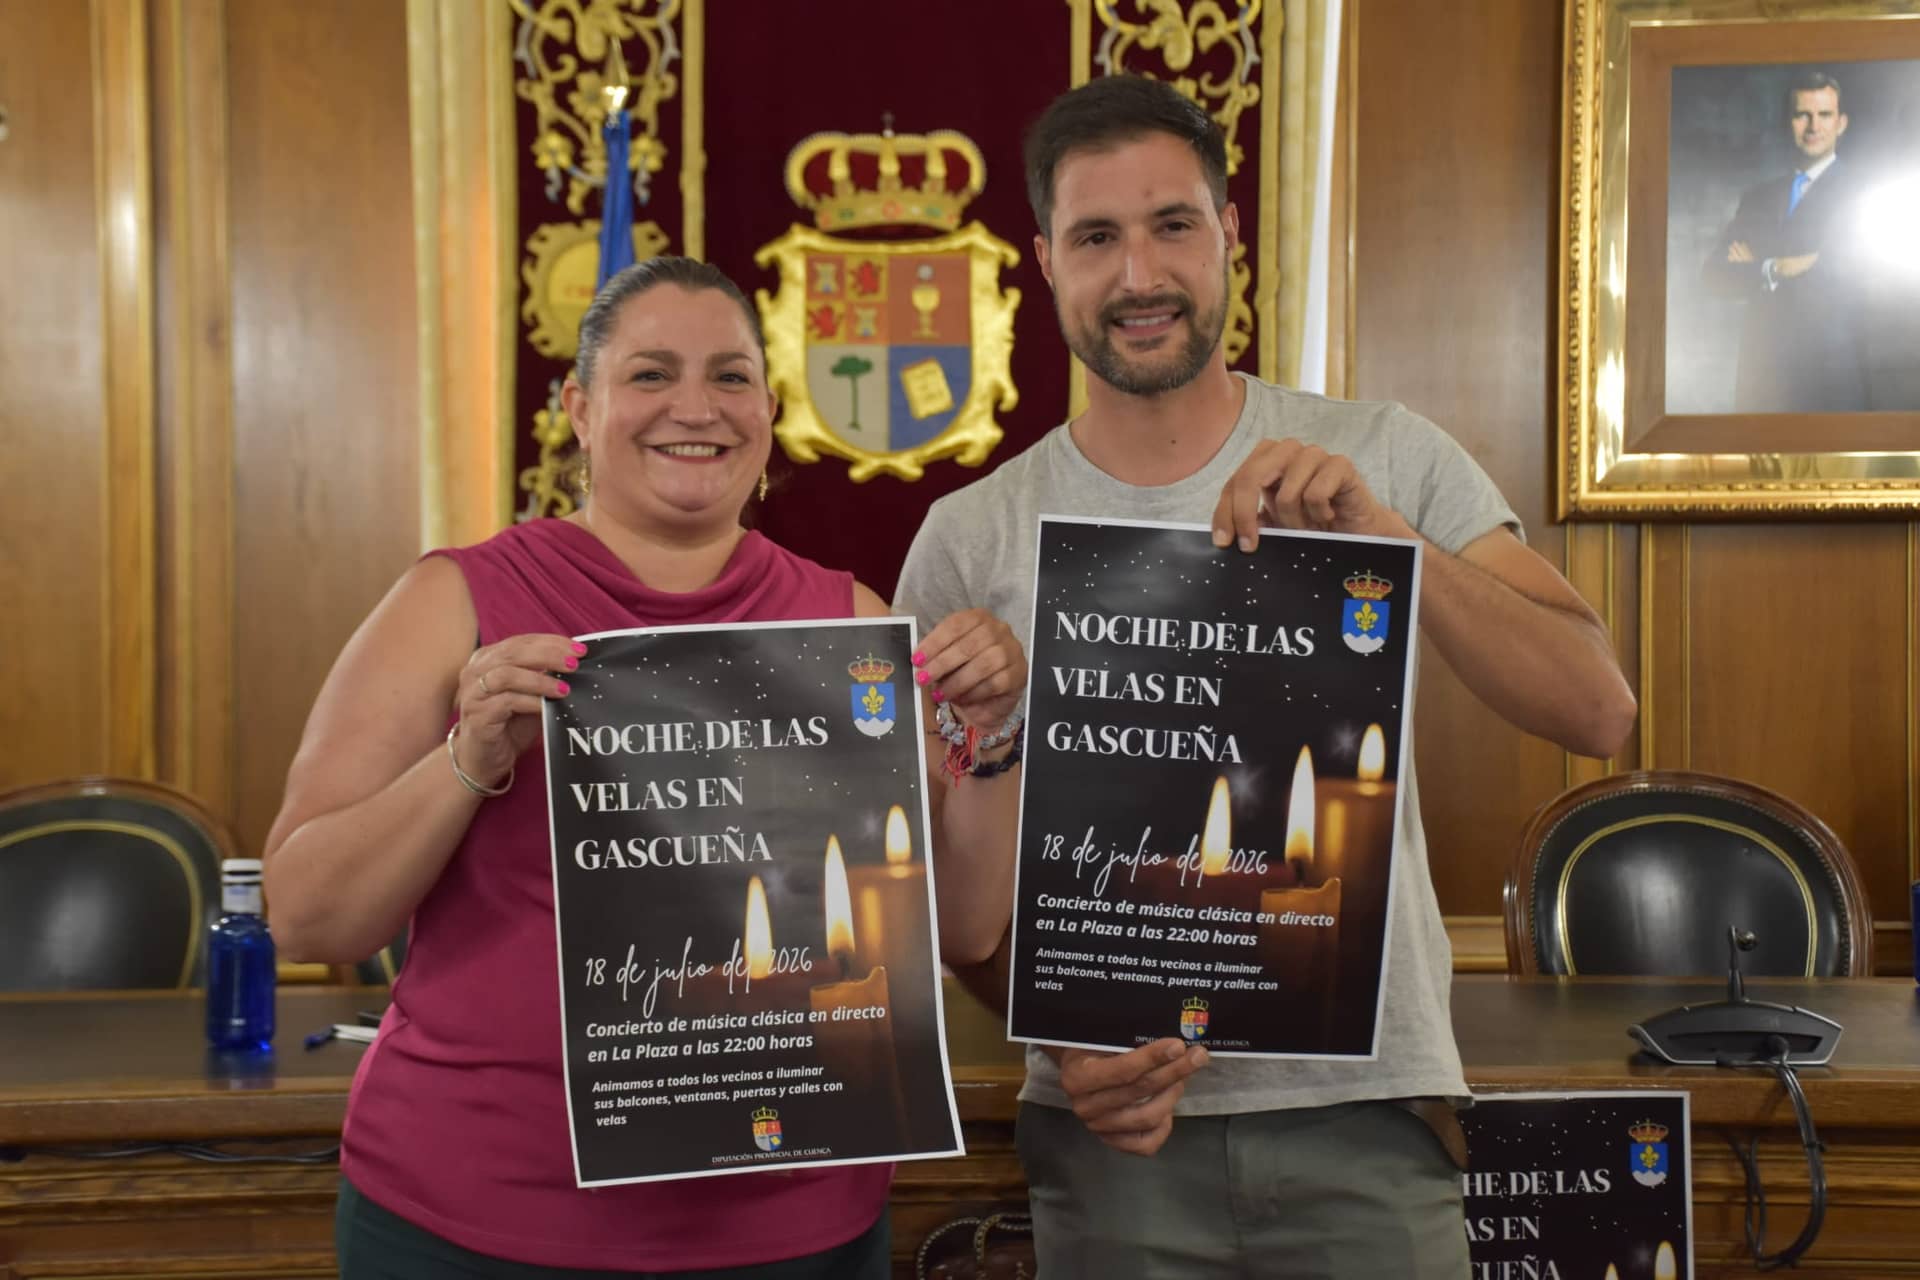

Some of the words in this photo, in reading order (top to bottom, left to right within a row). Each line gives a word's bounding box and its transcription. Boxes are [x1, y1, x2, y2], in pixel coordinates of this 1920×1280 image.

[1055, 611, 1180, 648] NOCHE
[1189, 621, 1236, 652] DE
[1246, 624, 1315, 657] LAS
[1051, 666, 1165, 703] VELAS
[1174, 675, 1223, 707] EN
[567, 720, 695, 756] NOCHE
[705, 719, 753, 750] DE
[763, 716, 829, 748] LAS
[1047, 721, 1243, 764] GASCUEÑA
[569, 778, 687, 812] VELAS
[697, 776, 744, 808] EN
[574, 826, 773, 870] GASCUEÑA
[1042, 834, 1064, 860] 18
[1072, 826, 1101, 879] de
[1094, 826, 1168, 898] julio
[1222, 848, 1268, 875] 2026
[1037, 894, 1111, 912] Concierto
[1115, 900, 1135, 914] de
[1138, 903, 1194, 919] música
[1198, 906, 1252, 923] clásica
[1256, 912, 1275, 924] en
[1279, 911, 1335, 927] directo
[1036, 919, 1055, 931] en
[1059, 918, 1077, 932] La
[1081, 920, 1123, 936] Plaza
[1126, 926, 1137, 937] a
[1140, 925, 1164, 939] las
[1166, 927, 1209, 943] 22:00
[1212, 929, 1258, 946] horas
[1035, 947, 1095, 962] Animamos
[1097, 954, 1105, 963] a
[1107, 954, 1139, 966] todos
[1141, 956, 1158, 968] los
[1160, 959, 1201, 971] vecinos
[1204, 963, 1212, 971] a
[1214, 962, 1263, 974] iluminar
[586, 958, 606, 986] 18
[616, 944, 646, 1002] de
[643, 936, 714, 1019] julio
[767, 946, 813, 975] 2026
[1035, 965, 1054, 974] sus
[1056, 965, 1108, 980] balcones,
[1111, 971, 1165, 986] ventanas,
[1168, 976, 1212, 988] puertas
[1213, 980, 1222, 991] y
[1223, 979, 1256, 990] calles
[1258, 981, 1278, 990] con
[1035, 980, 1063, 991] velas
[586, 1020, 663, 1038] Concierto
[668, 1017, 688, 1032] de
[691, 1013, 747, 1031] música
[751, 1010, 804, 1027] clásica
[808, 1010, 827, 1022] en
[831, 1006, 886, 1021] directo
[588, 1050, 607, 1062] en
[612, 1046, 631, 1060] La
[635, 1043, 678, 1059] Plaza
[682, 1044, 692, 1055] a
[697, 1040, 720, 1055] las
[723, 1036, 765, 1053] 22:00
[769, 1034, 813, 1050] horas
[592, 1080, 654, 1093] Animamos
[657, 1078, 664, 1087] a
[667, 1074, 700, 1087] todos
[702, 1073, 719, 1084] los
[721, 1070, 763, 1082] vecinos
[766, 1070, 774, 1079] a
[776, 1065, 824, 1078] iluminar
[594, 1099, 614, 1110] sus
[617, 1096, 671, 1108] balcones,
[674, 1091, 730, 1103] ventanas,
[733, 1086, 777, 1102] puertas
[779, 1086, 786, 1098] y
[788, 1082, 820, 1095] calles
[823, 1082, 843, 1091] con
[596, 1114, 627, 1127] velas
[1509, 1170, 1549, 1196] DE
[1556, 1168, 1611, 1194] LAS
[1502, 1216, 1539, 1240] EN
